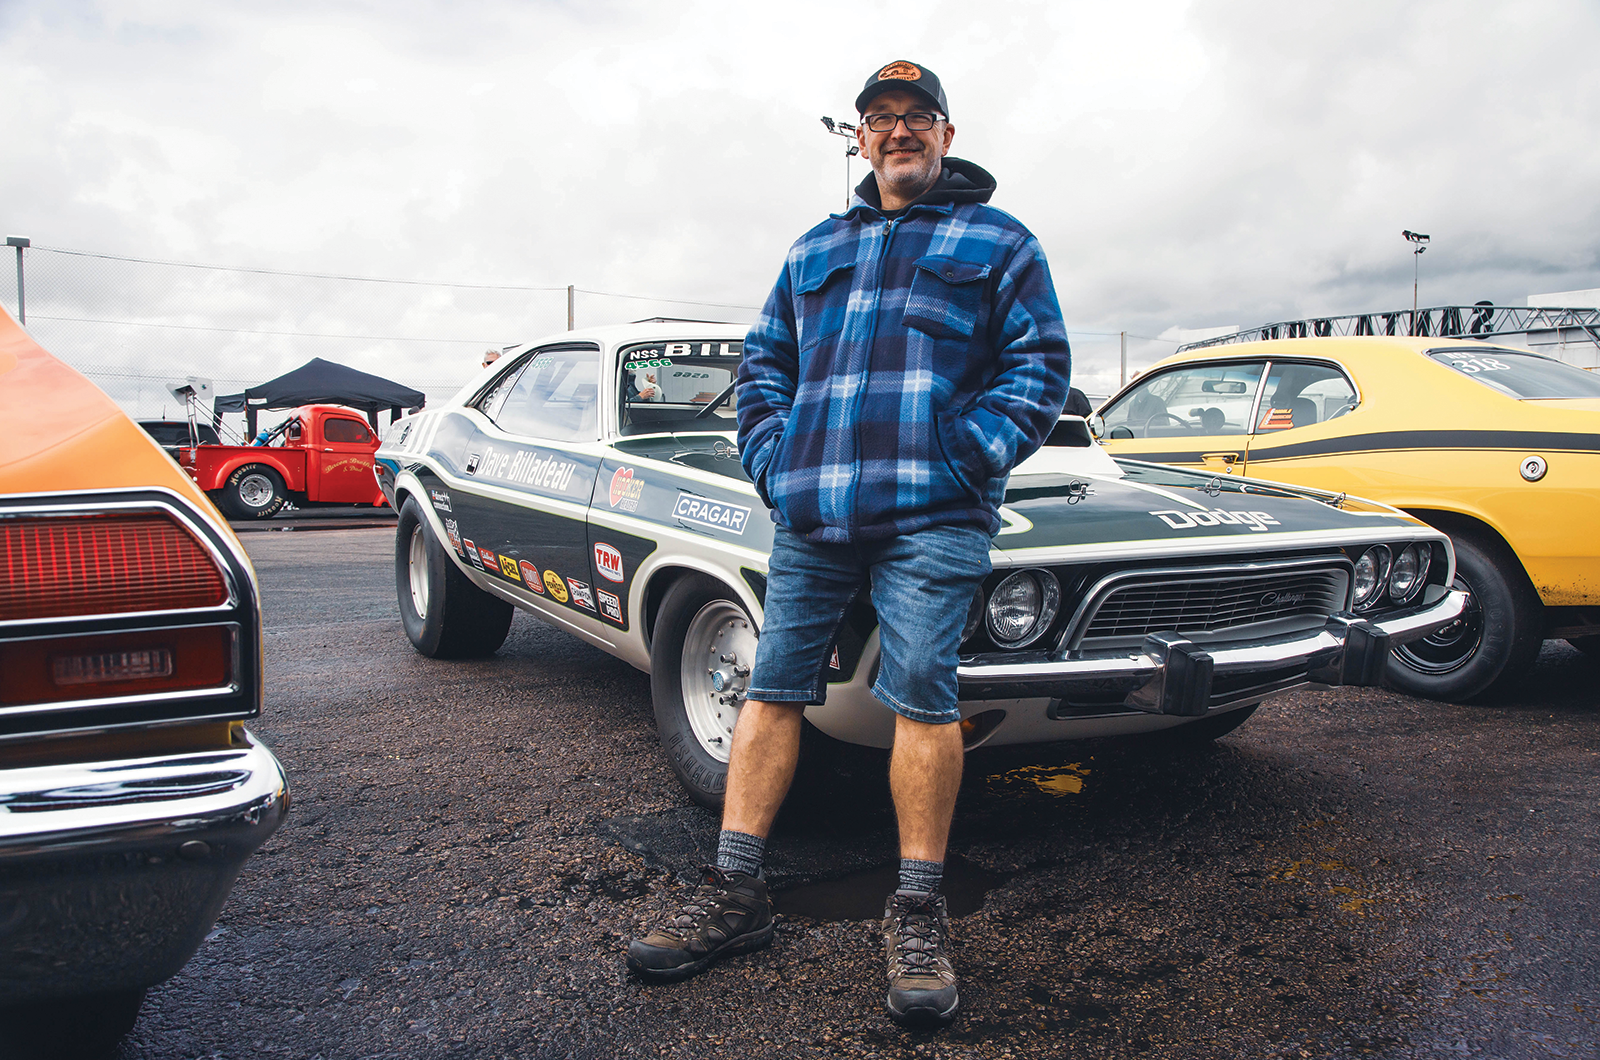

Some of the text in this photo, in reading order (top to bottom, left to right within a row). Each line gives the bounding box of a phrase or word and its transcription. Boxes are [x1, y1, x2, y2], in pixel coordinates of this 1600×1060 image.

[630, 349, 658, 361] NSS
[664, 343, 741, 357] BIL
[624, 358, 673, 371] 4566
[1452, 357, 1511, 373] 318
[478, 446, 577, 491] Dave Billadeau
[612, 475, 645, 500] HOOKER
[677, 498, 745, 529] CRAGAR
[1148, 508, 1282, 531] Dodge
[596, 548, 620, 571] TRW
[598, 591, 618, 608] SPEED
[1259, 592, 1306, 607] Challenger
[606, 605, 620, 619] PRO
